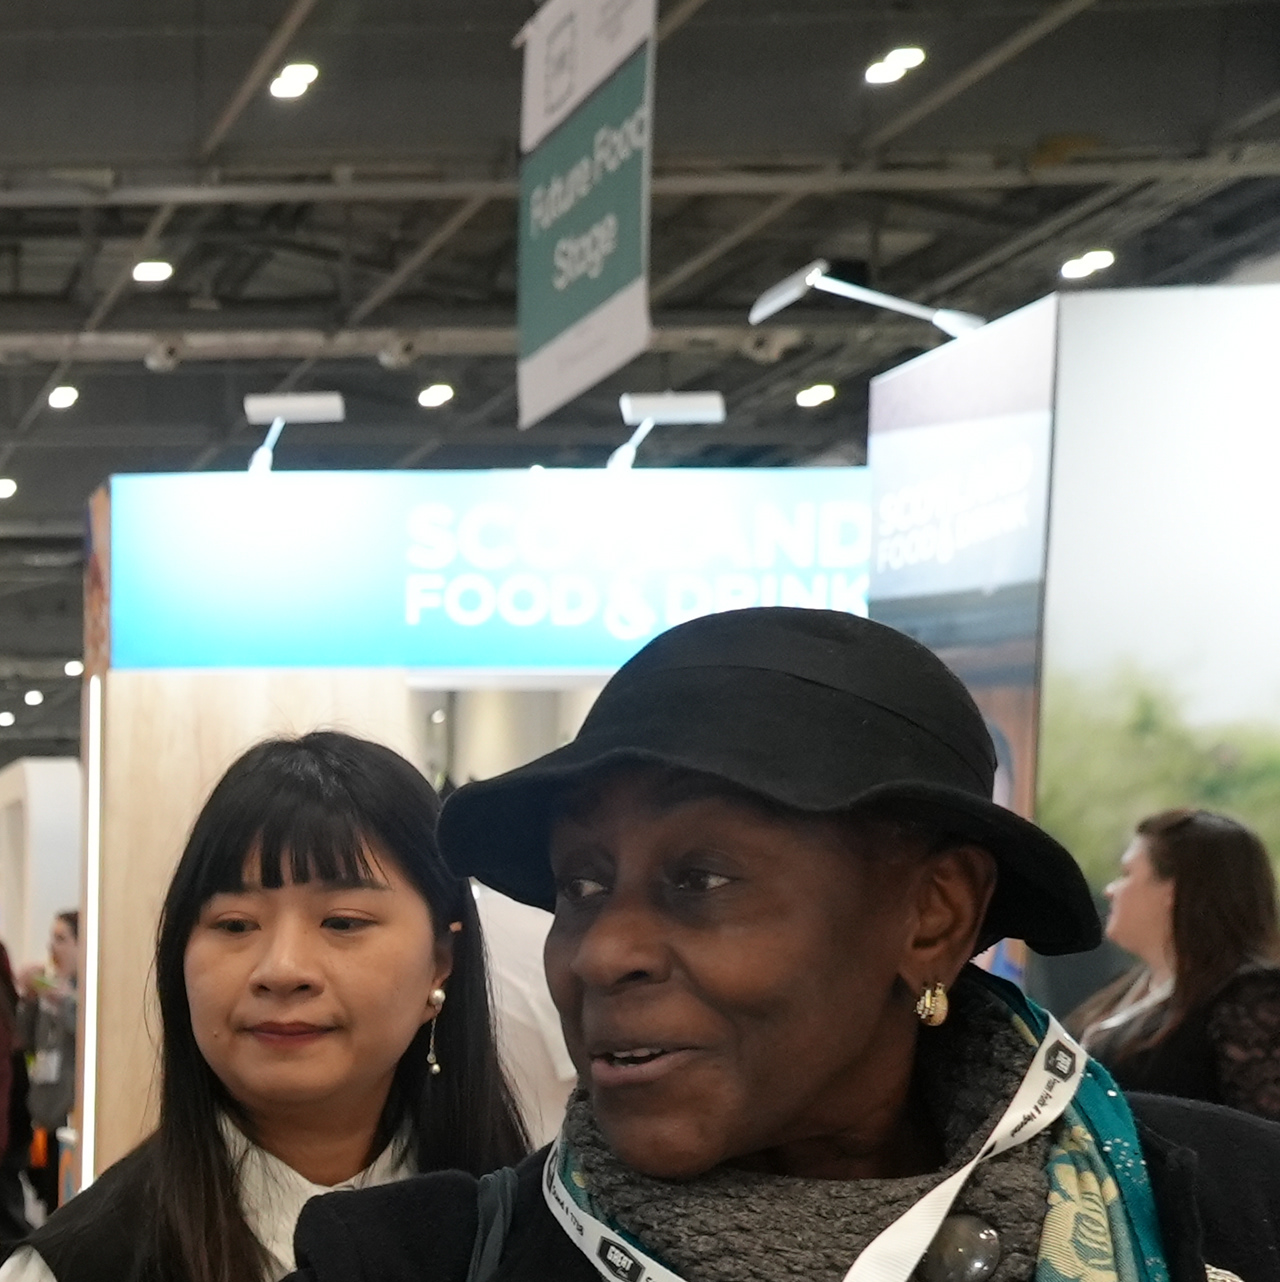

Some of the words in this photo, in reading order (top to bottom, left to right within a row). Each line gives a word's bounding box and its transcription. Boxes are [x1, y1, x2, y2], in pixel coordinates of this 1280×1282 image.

[530, 155, 591, 239] Future
[553, 213, 619, 291] Stage
[404, 500, 873, 570] SCOAND
[406, 574, 599, 627] FOOD
[604, 570, 657, 641] &
[666, 573, 870, 627] DRINK
